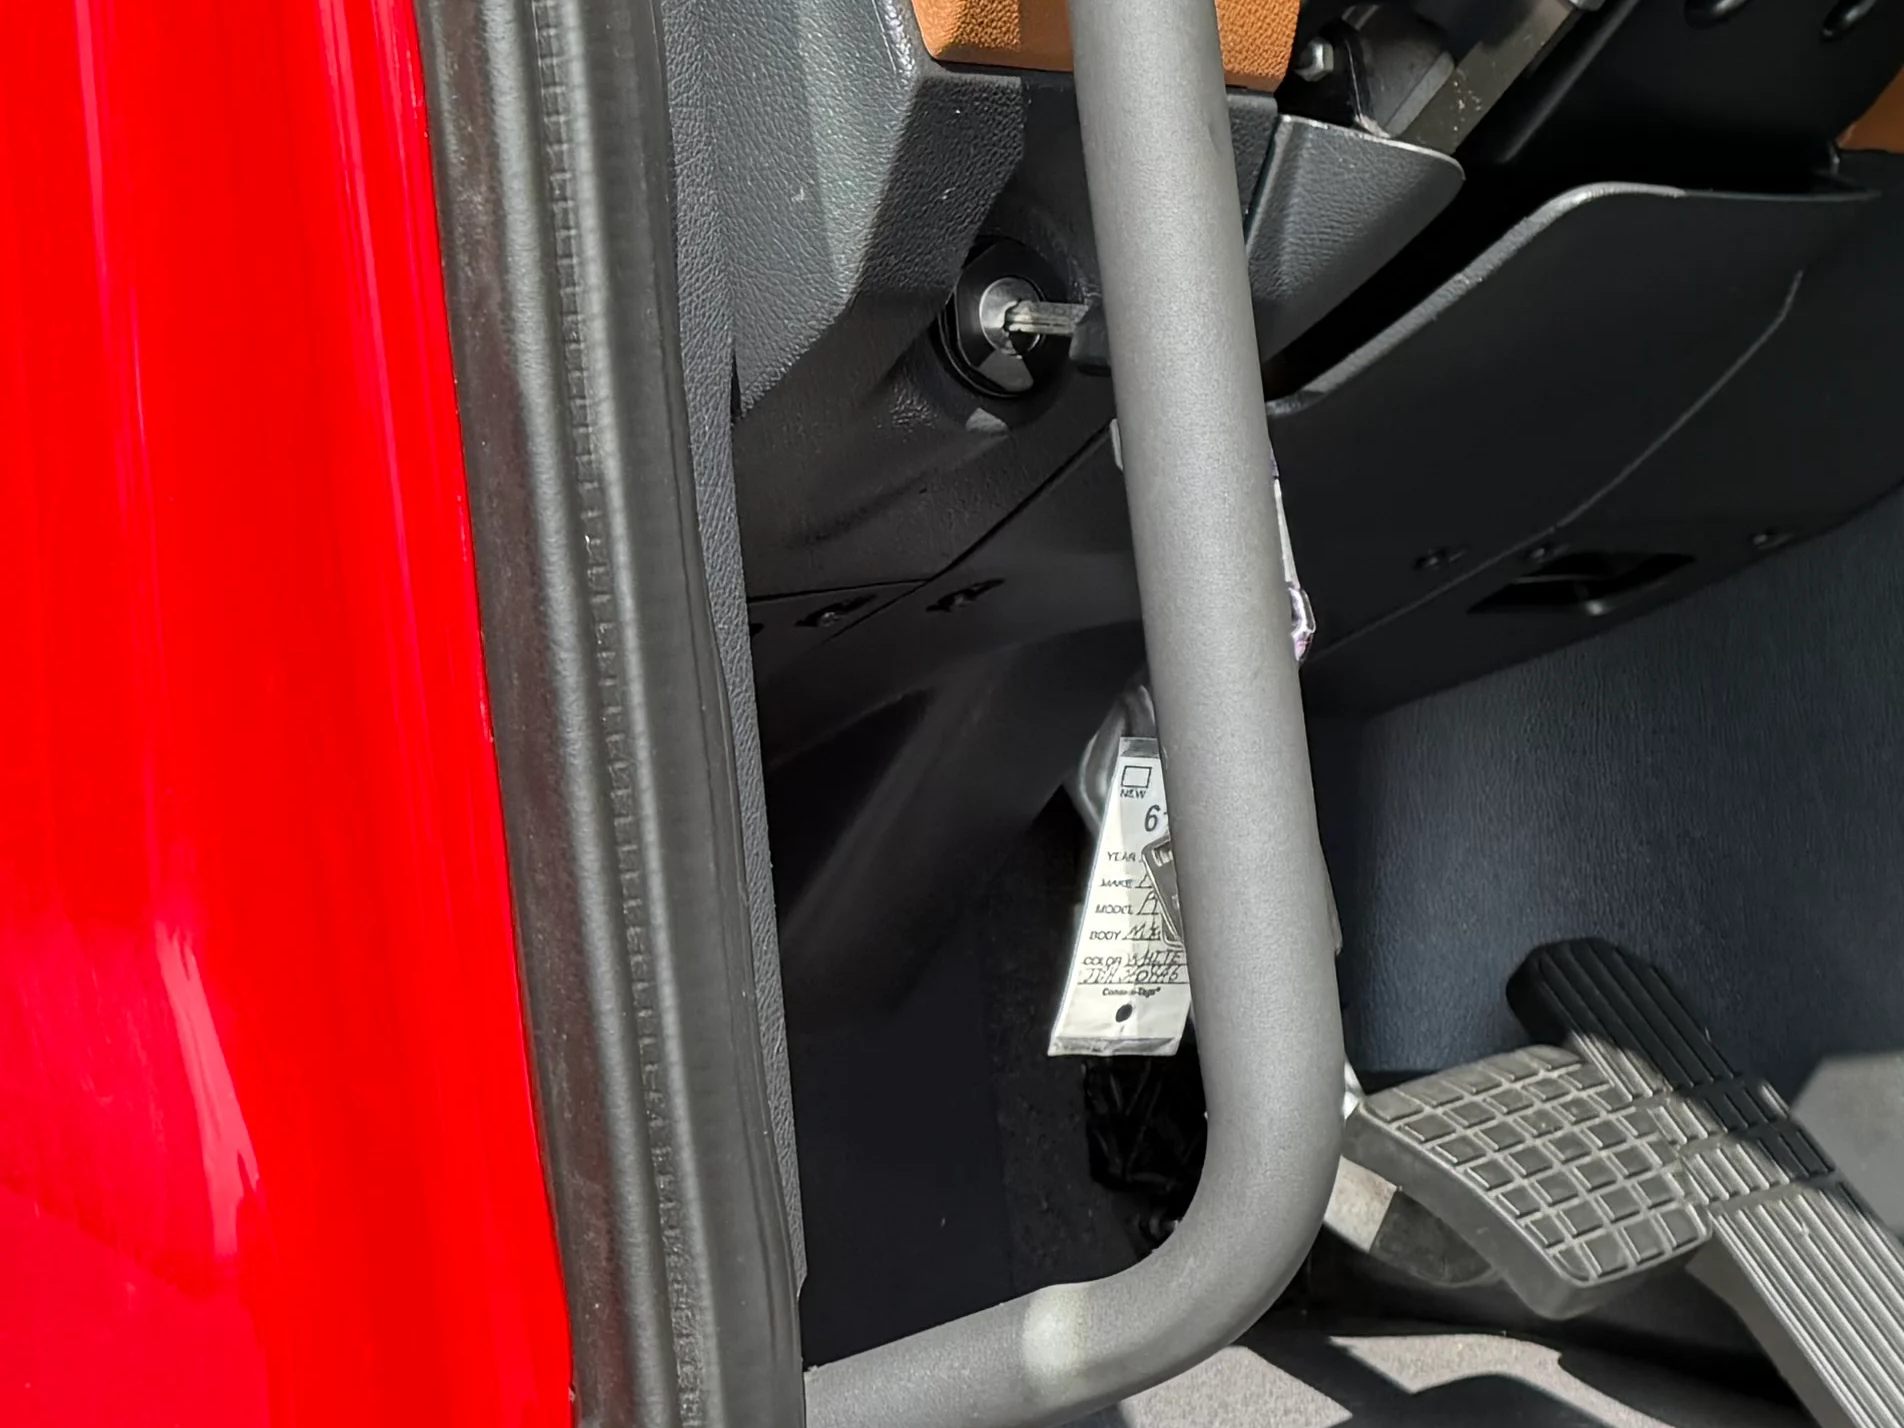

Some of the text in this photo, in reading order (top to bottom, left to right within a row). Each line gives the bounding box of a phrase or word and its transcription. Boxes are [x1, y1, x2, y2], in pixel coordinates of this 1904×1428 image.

[1120, 788, 1147, 799] NEW
[1106, 851, 1137, 863] YEAR
[1099, 877, 1133, 888] MAKE
[1094, 903, 1134, 916] MODEL
[1088, 929, 1122, 941] BODY
[1082, 955, 1123, 966] COLOR
